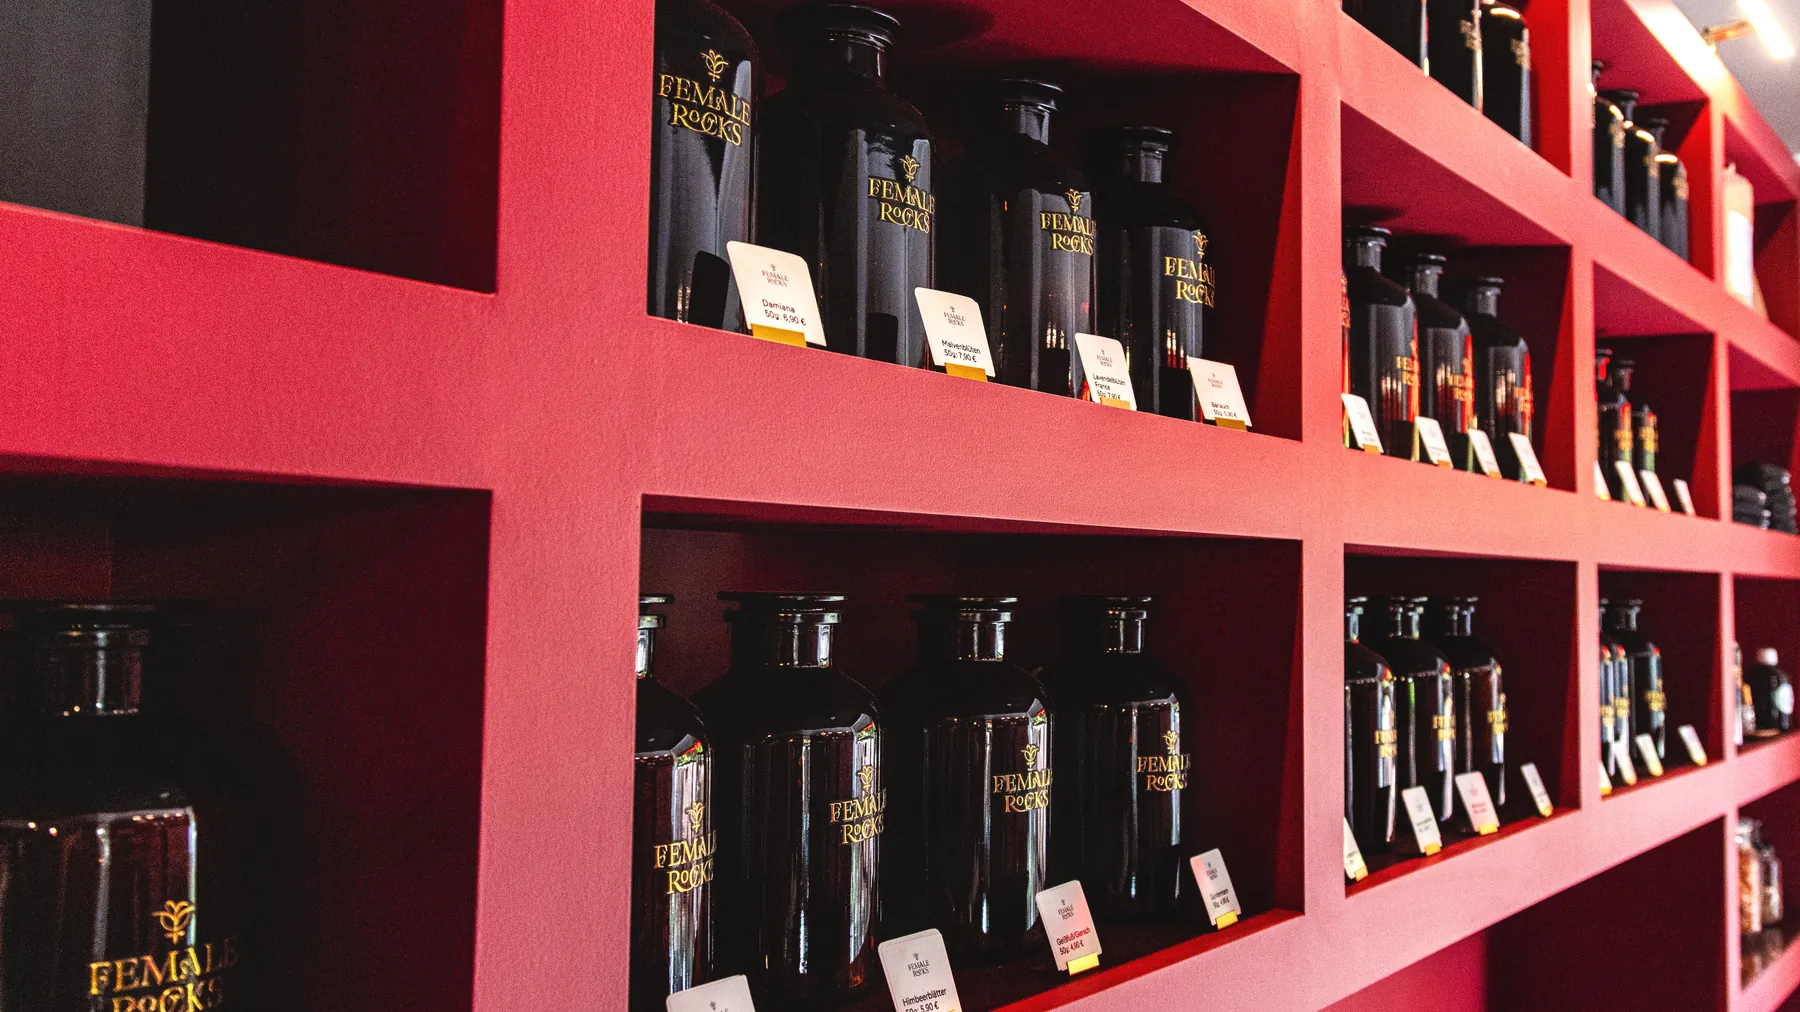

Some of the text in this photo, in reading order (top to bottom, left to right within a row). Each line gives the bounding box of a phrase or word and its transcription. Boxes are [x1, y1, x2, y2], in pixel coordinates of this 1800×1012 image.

[657, 73, 750, 126] FEMALE
[868, 177, 935, 214] FEMALE
[761, 299, 795, 314] Damiana
[800, 318, 807, 326] €
[941, 340, 981, 354] Malvenblüten
[1080, 939, 1085, 947] €
[908, 960, 930, 971] FEMALE
[901, 988, 947, 1007] Himbeerblätter
[934, 1001, 940, 1010] €
